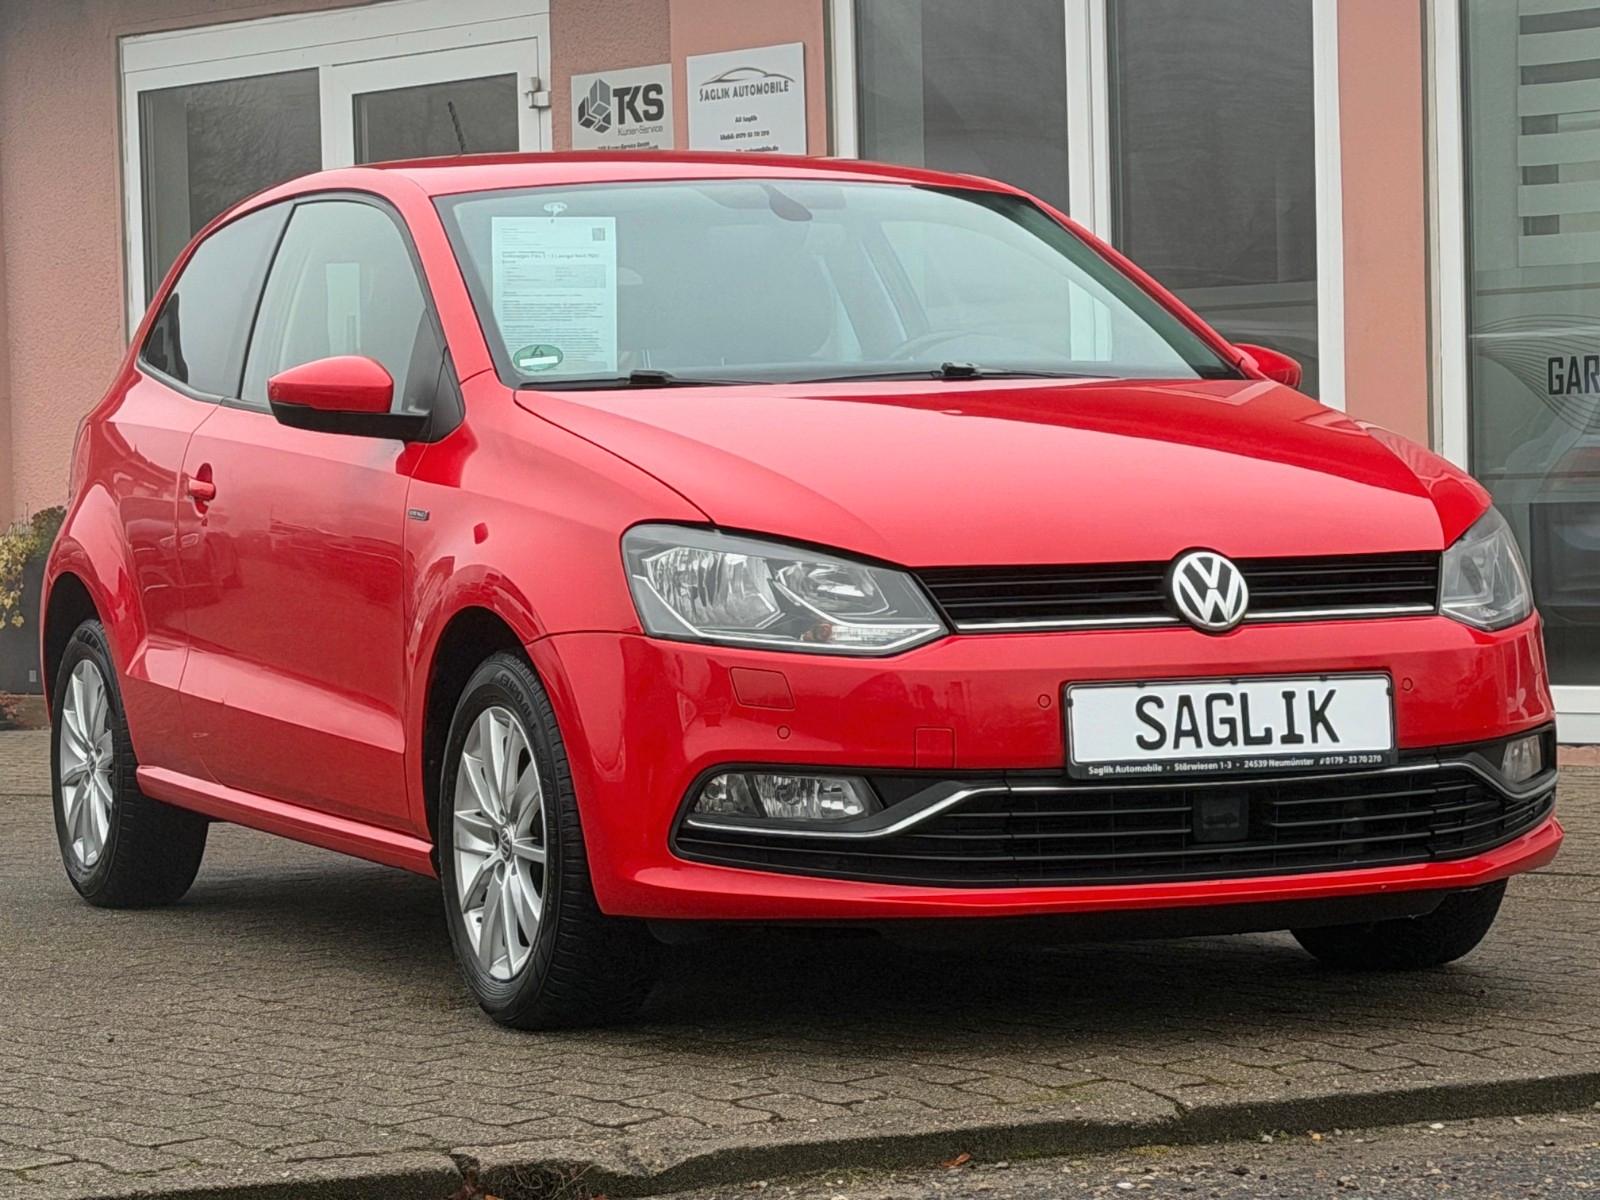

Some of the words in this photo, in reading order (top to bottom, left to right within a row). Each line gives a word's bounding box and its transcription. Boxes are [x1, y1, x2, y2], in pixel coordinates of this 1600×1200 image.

[612, 83, 665, 125] TKS
[699, 87, 730, 102] SAGLIK
[732, 80, 789, 98] AUTOMOBILE
[1548, 355, 1600, 395] GAR
[1135, 689, 1340, 751] SAGLIK
[1088, 766, 1114, 776] Saglik
[1115, 764, 1163, 774] Automobile
[1174, 762, 1219, 771] Störwiesen
[1220, 761, 1232, 769] 1-3
[1243, 759, 1268, 768] 24539
[1268, 757, 1315, 767] Neumünster
